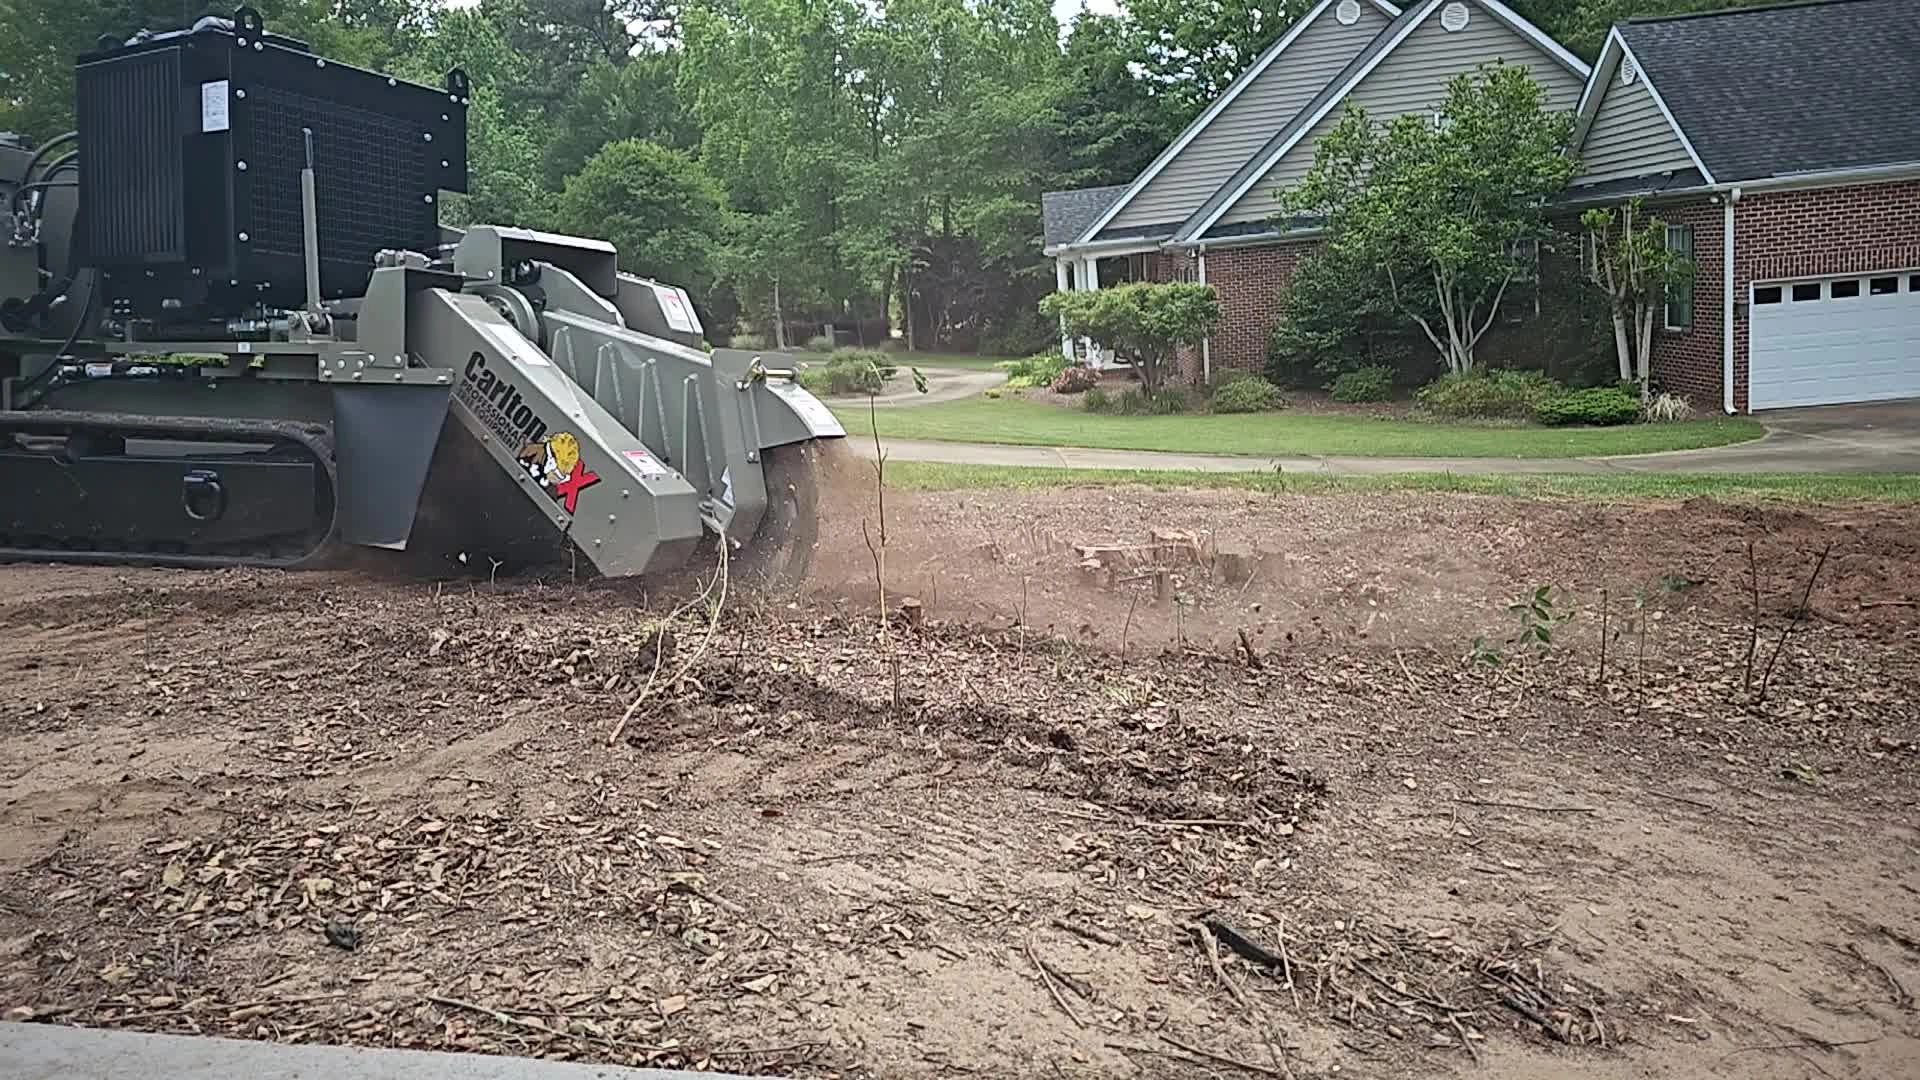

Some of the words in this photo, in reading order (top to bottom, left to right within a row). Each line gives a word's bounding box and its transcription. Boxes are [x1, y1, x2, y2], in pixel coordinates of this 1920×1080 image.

[460, 380, 527, 442] PROFESSIONAL
[465, 351, 549, 442] Carlton
[474, 404, 520, 451] EQUIPMENT
